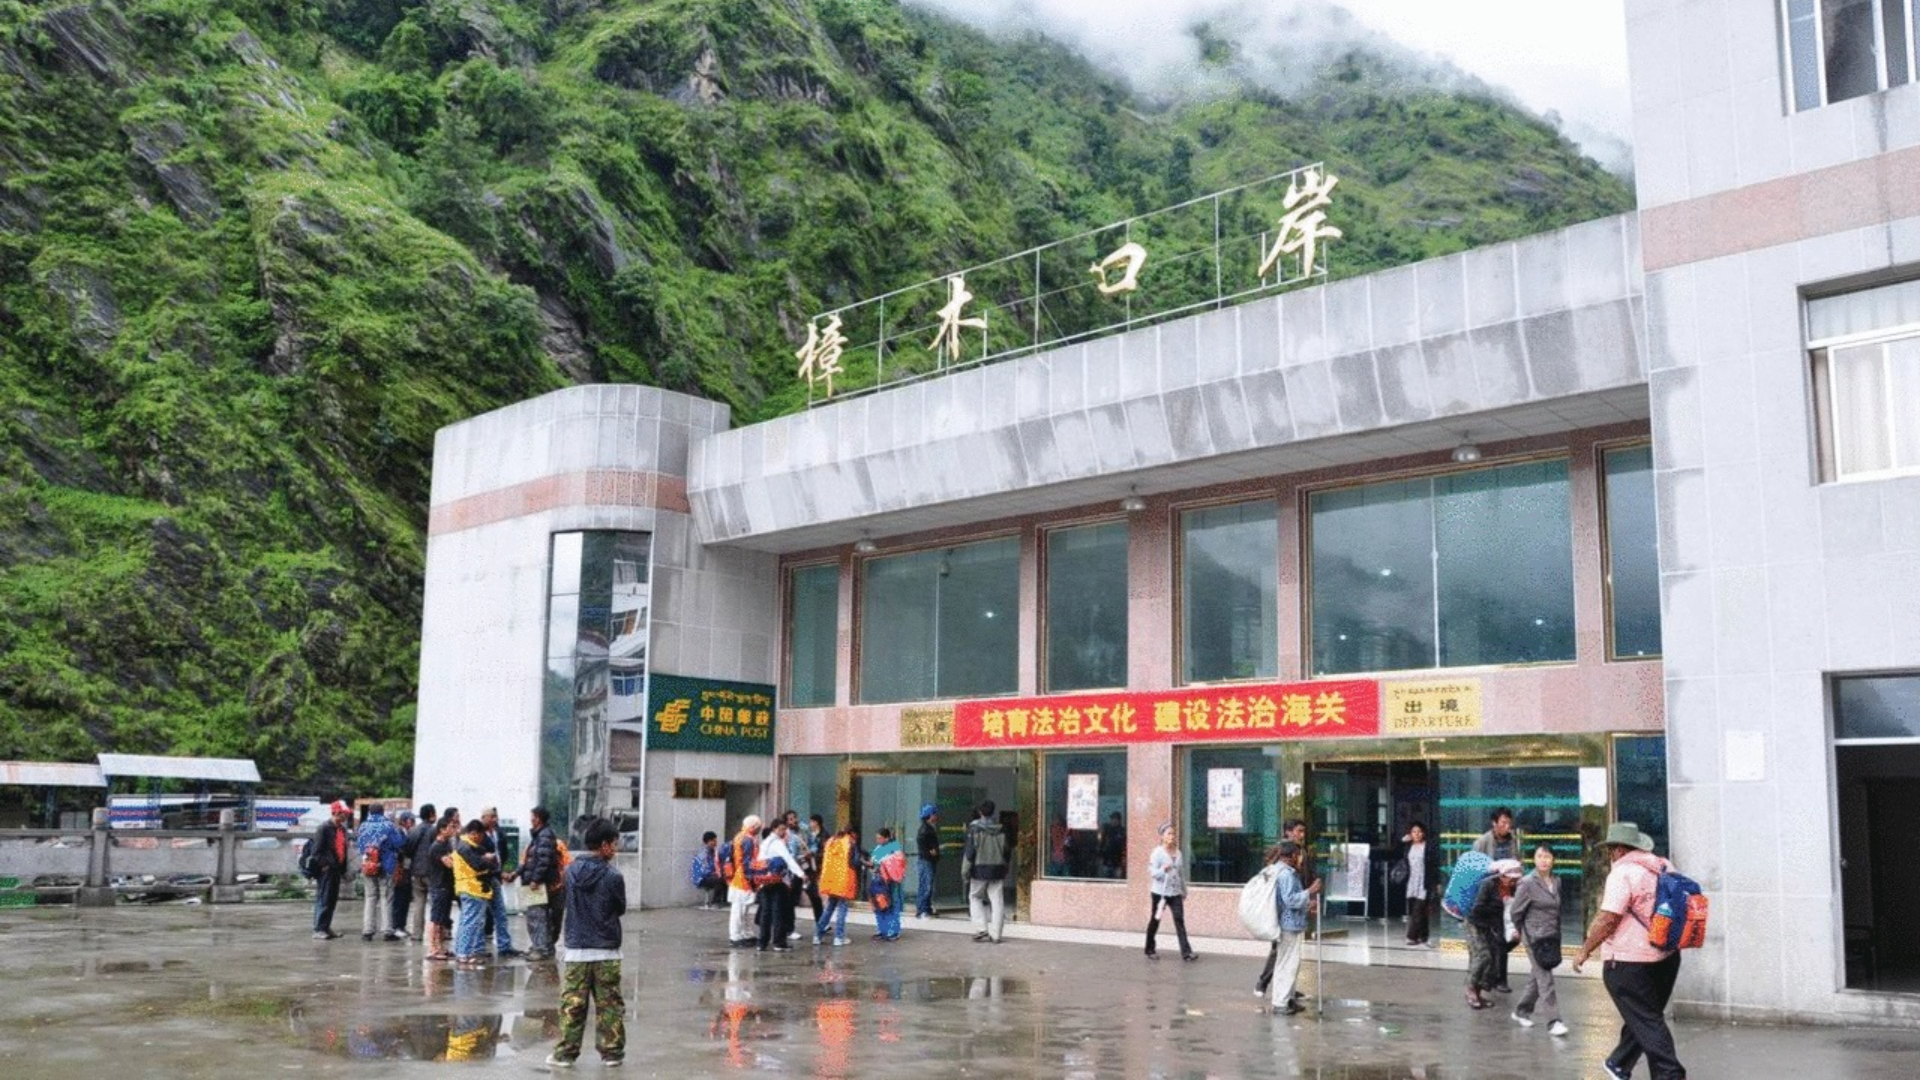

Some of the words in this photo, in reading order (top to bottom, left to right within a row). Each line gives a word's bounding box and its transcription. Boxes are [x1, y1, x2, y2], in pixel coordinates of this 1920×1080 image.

[796, 168, 1344, 399] 樟木口岸
[701, 704, 769, 726] 中国邮政
[982, 702, 1138, 738] 培育法治文化
[1153, 690, 1347, 733] 建设法治海关
[1404, 699, 1459, 714] 出境
[700, 723, 736, 736] CHINA
[741, 726, 768, 738] POST
[1394, 714, 1474, 729] DEPARTURE
